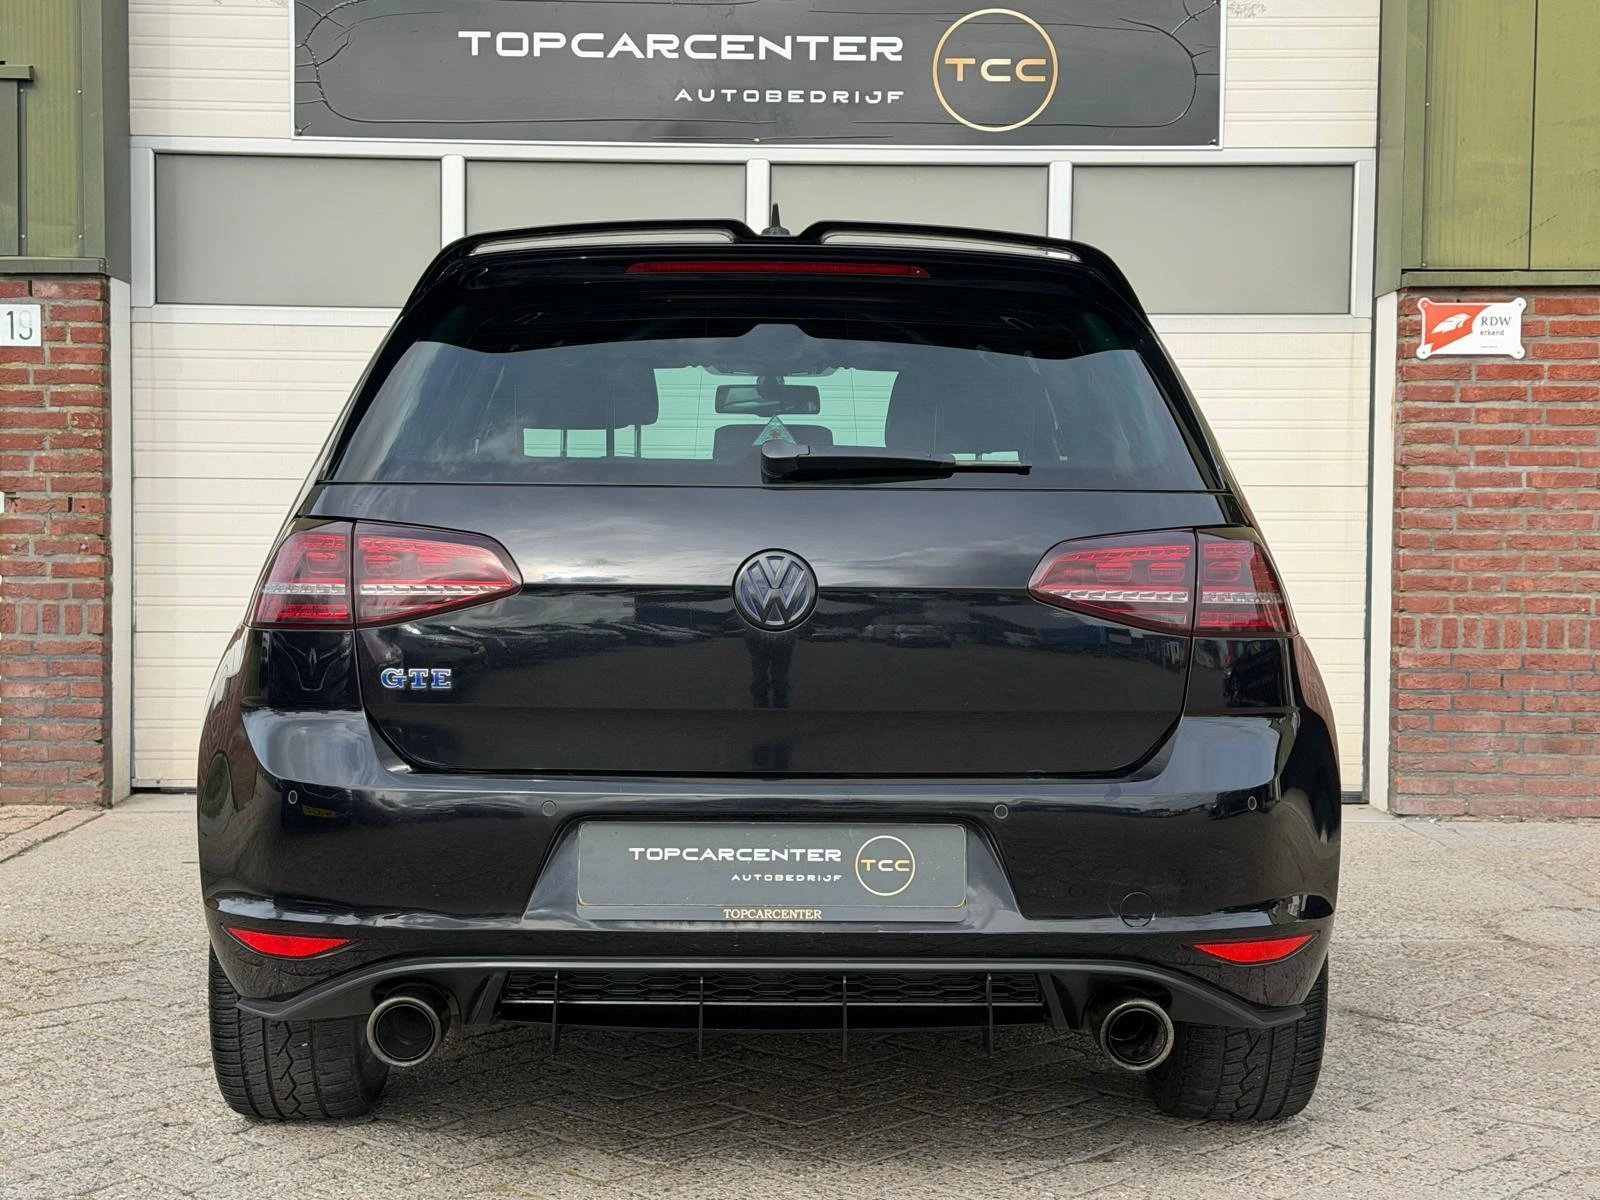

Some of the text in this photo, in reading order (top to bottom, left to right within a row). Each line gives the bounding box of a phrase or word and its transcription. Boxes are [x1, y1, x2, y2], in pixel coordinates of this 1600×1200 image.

[457, 30, 905, 62] TOPCARCENTER
[943, 57, 1047, 83] TCC
[674, 88, 905, 105] AUTOBEDRIJF
[6, 309, 33, 340] 19
[1480, 316, 1512, 326] RDW
[1479, 328, 1504, 336] erkend
[380, 667, 452, 689] GTE
[628, 846, 842, 862] TOPCARCENTER
[860, 859, 910, 872] TCC
[731, 873, 843, 882] AUTOBEDRIJF
[723, 908, 822, 920] TOPCARCENTER
